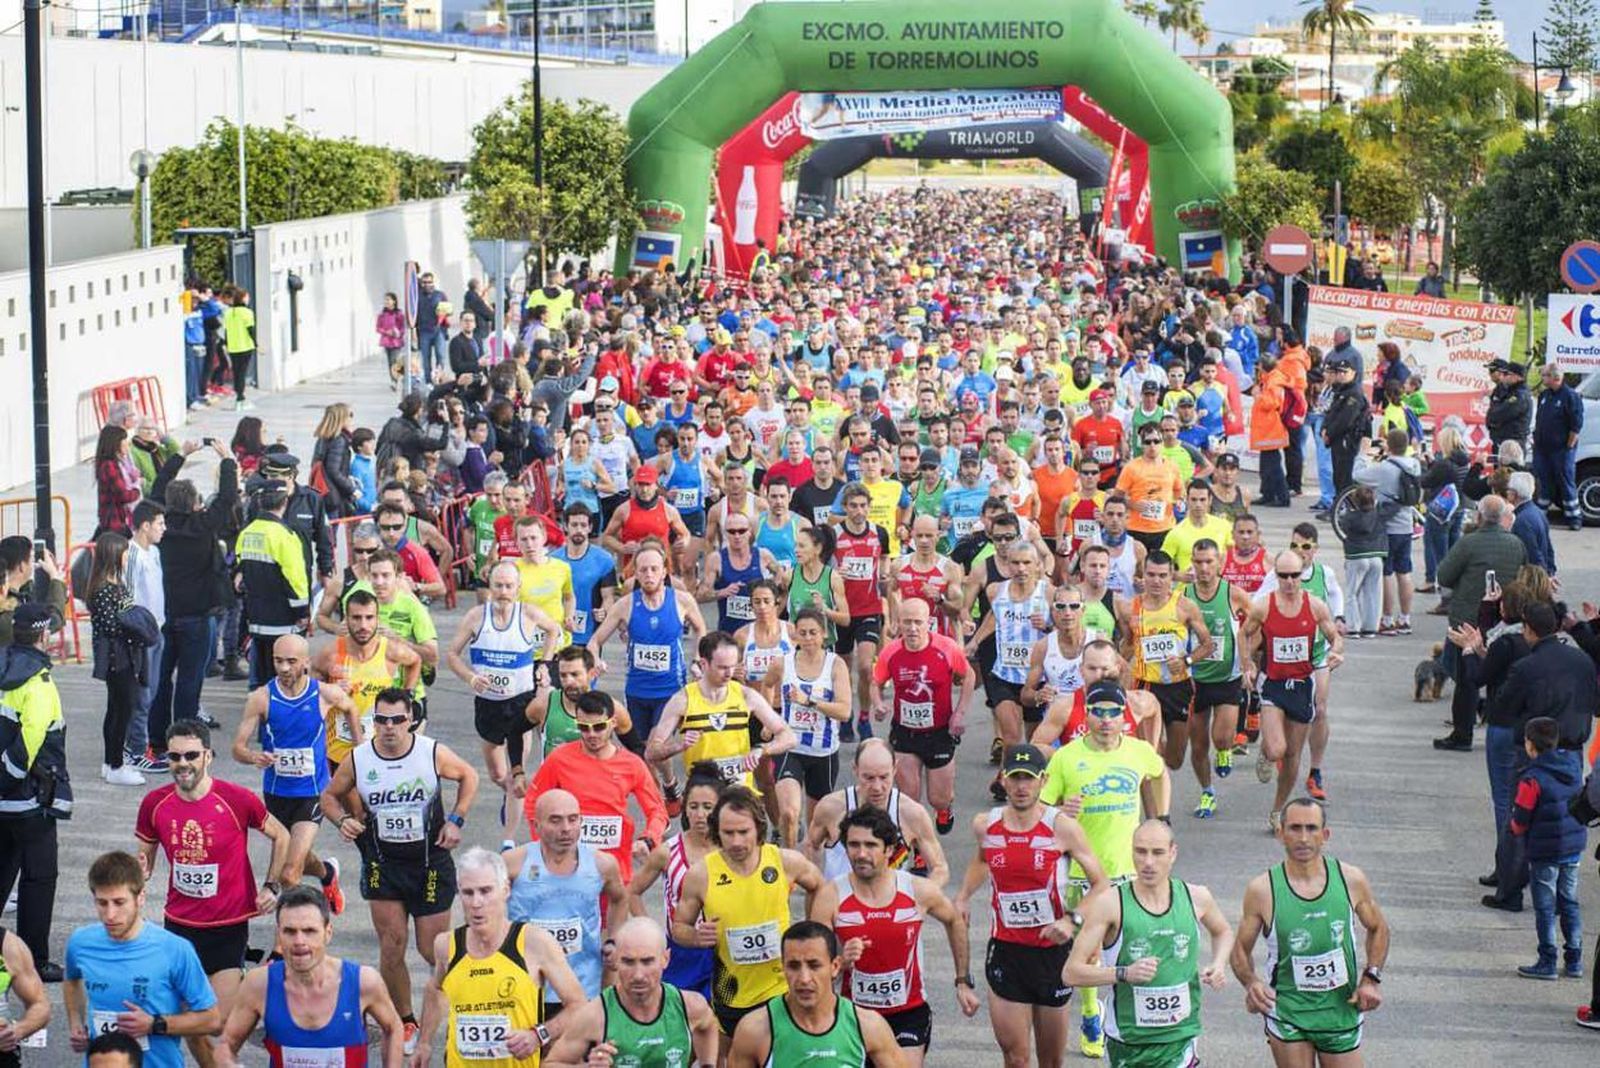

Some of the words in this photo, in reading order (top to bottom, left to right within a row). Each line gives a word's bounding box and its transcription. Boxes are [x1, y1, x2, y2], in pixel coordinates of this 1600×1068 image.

[802, 22, 889, 41] EXCMO.
[900, 21, 1065, 41] AYUNTAMIENTO
[828, 51, 856, 70] DE
[868, 50, 1040, 70] TORREMOLINOS
[880, 95, 951, 110] Media
[948, 131, 1036, 145] TRIAWORLD
[1371, 296, 1392, 309] tus
[1454, 304, 1478, 319] con
[1007, 647, 1028, 658] 789
[1146, 641, 1174, 652] 1305
[1280, 643, 1303, 653] 413
[638, 650, 667, 661] 1452
[795, 711, 818, 723] 921
[903, 706, 930, 718] 1192
[280, 755, 304, 766] 511
[369, 788, 426, 806] BICHA
[386, 817, 413, 830] 591
[581, 824, 617, 837] 1556
[175, 870, 213, 885] 1332
[1009, 901, 1040, 914] 451
[548, 927, 578, 942] 89
[743, 934, 766, 949] 30
[1304, 960, 1336, 978] 231
[857, 979, 902, 994] 1456
[1145, 995, 1181, 1011] 382
[459, 1026, 506, 1042] 1312
